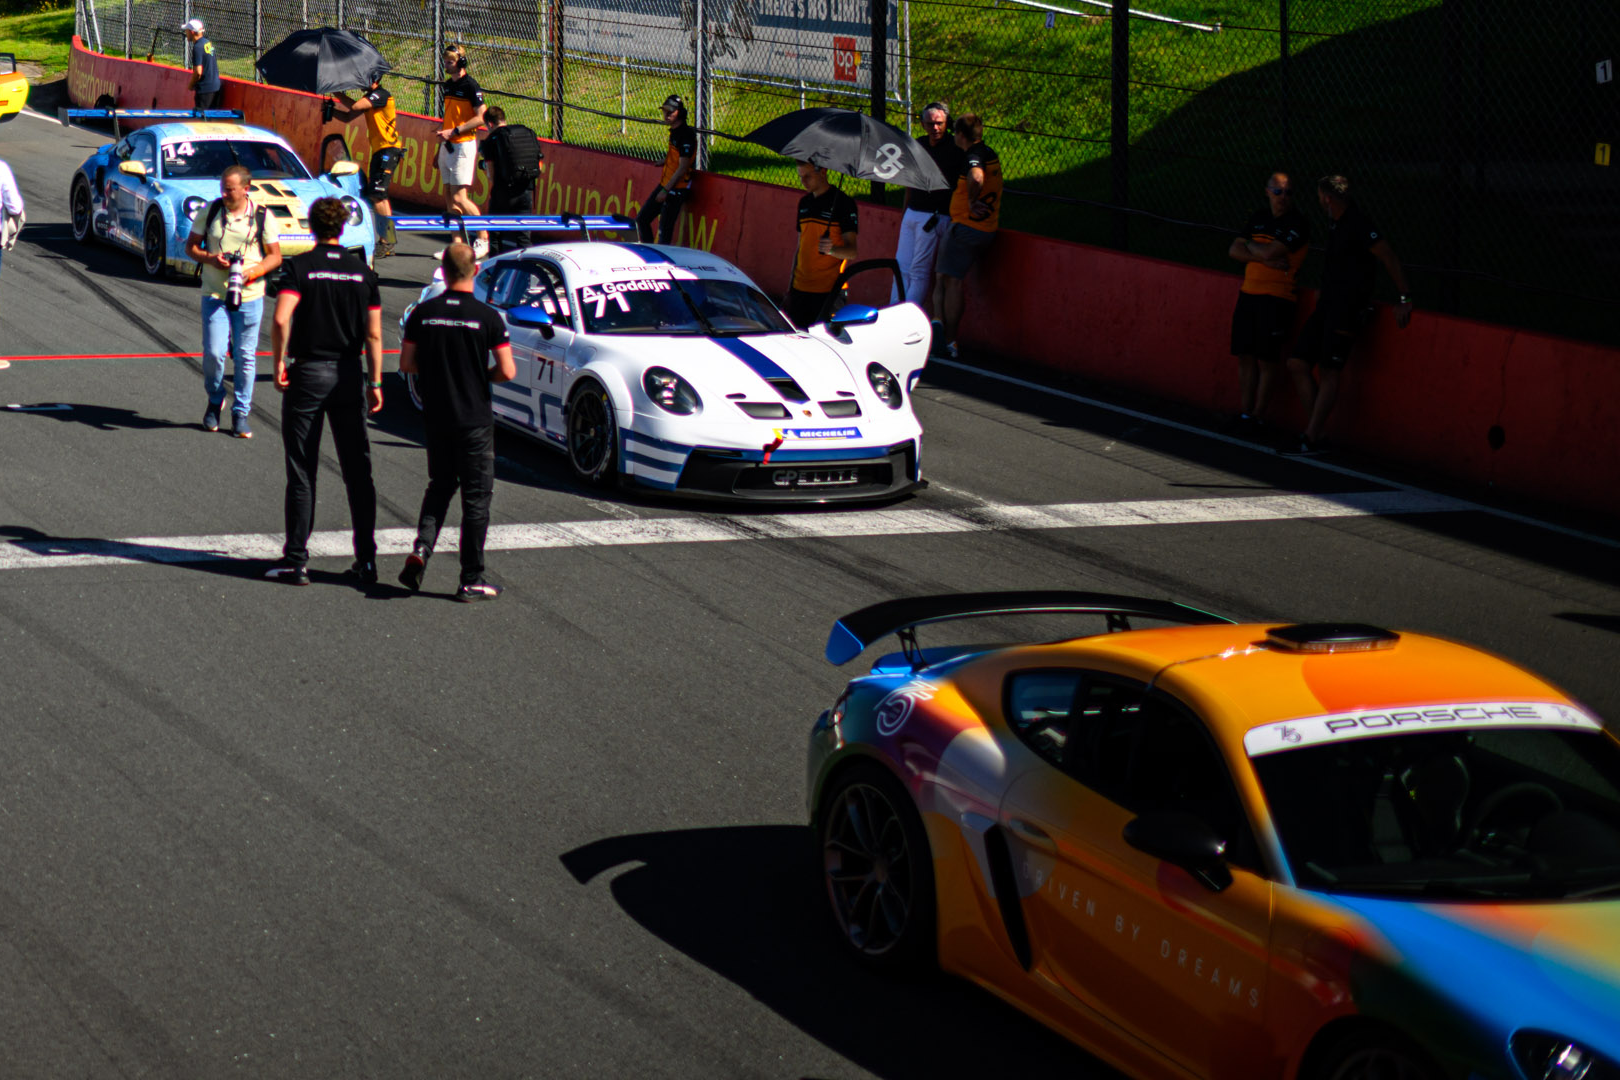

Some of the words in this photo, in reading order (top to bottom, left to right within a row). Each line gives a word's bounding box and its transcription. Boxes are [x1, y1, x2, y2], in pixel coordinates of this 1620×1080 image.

[161, 141, 195, 161] 14
[308, 272, 363, 283] PORSCHE
[611, 265, 719, 273] PORSCHE
[582, 285, 600, 299] A.
[601, 279, 671, 293] Goddijn
[582, 292, 631, 319] 71
[422, 319, 480, 330] PORSCHE
[537, 356, 555, 384] 71
[799, 429, 856, 438] MICHELIN
[1325, 706, 1542, 734] PORSCHE
[1114, 914, 1141, 941] BY
[1160, 939, 1260, 1010] DREAMS
